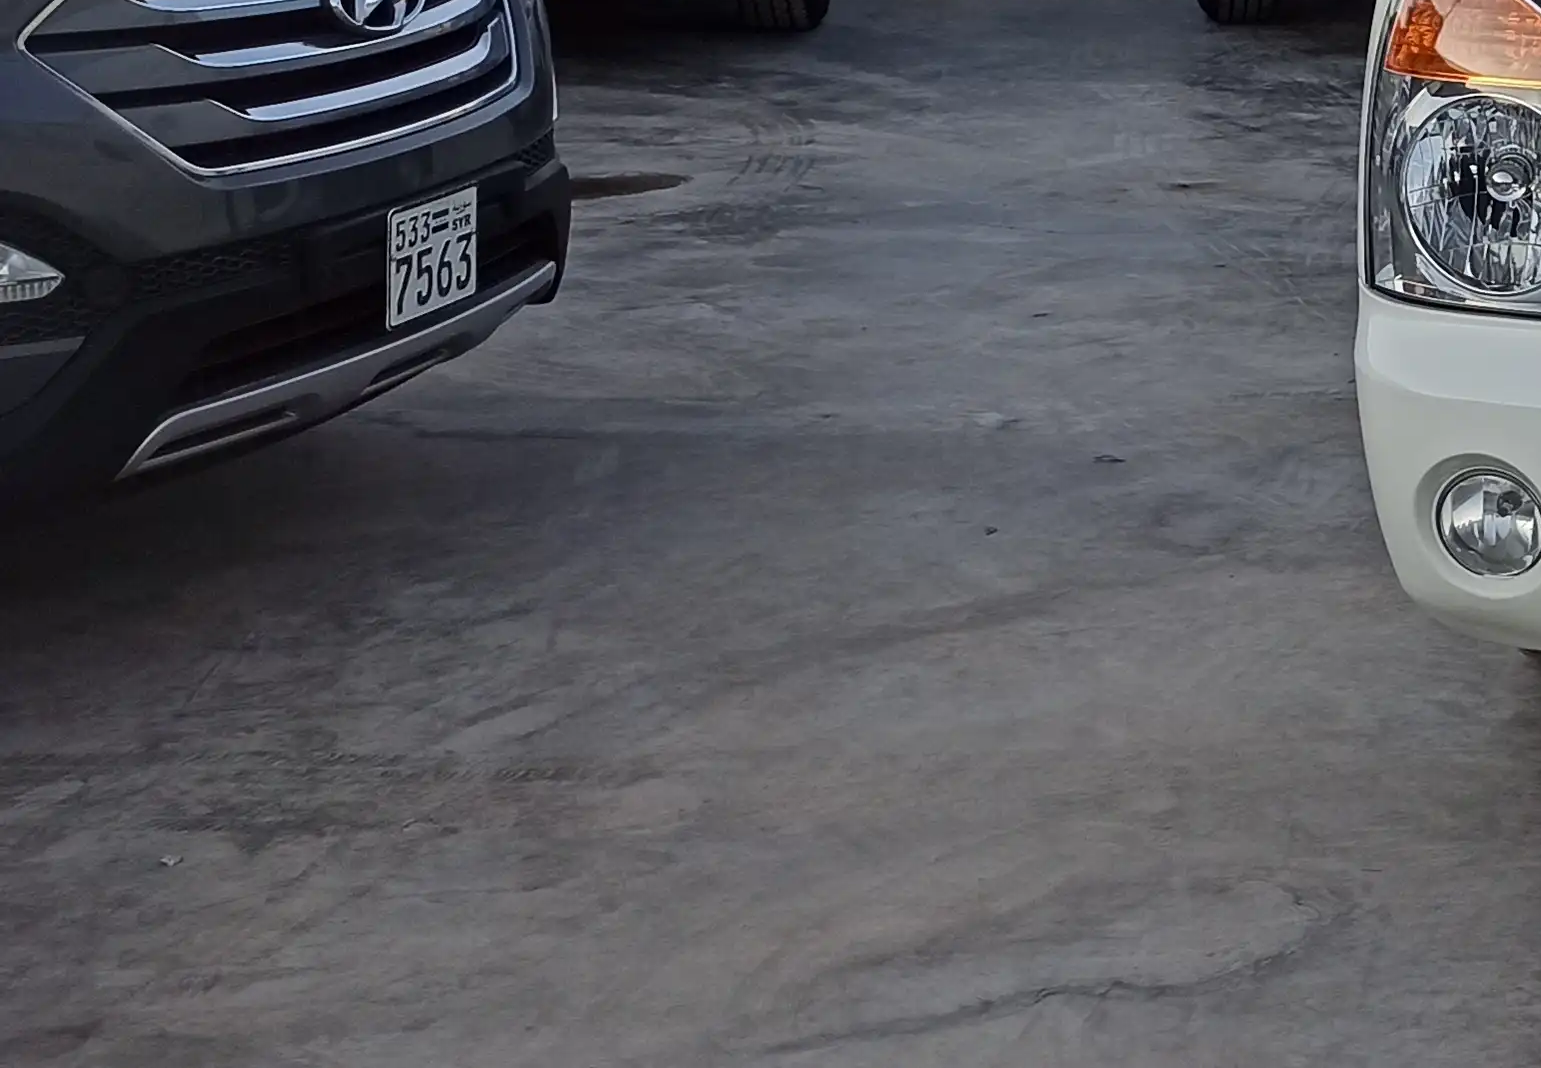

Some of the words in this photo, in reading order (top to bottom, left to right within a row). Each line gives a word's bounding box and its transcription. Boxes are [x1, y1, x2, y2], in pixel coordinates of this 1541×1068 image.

[395, 211, 431, 252] 533
[452, 213, 473, 231] SYR
[396, 231, 473, 316] 7563
